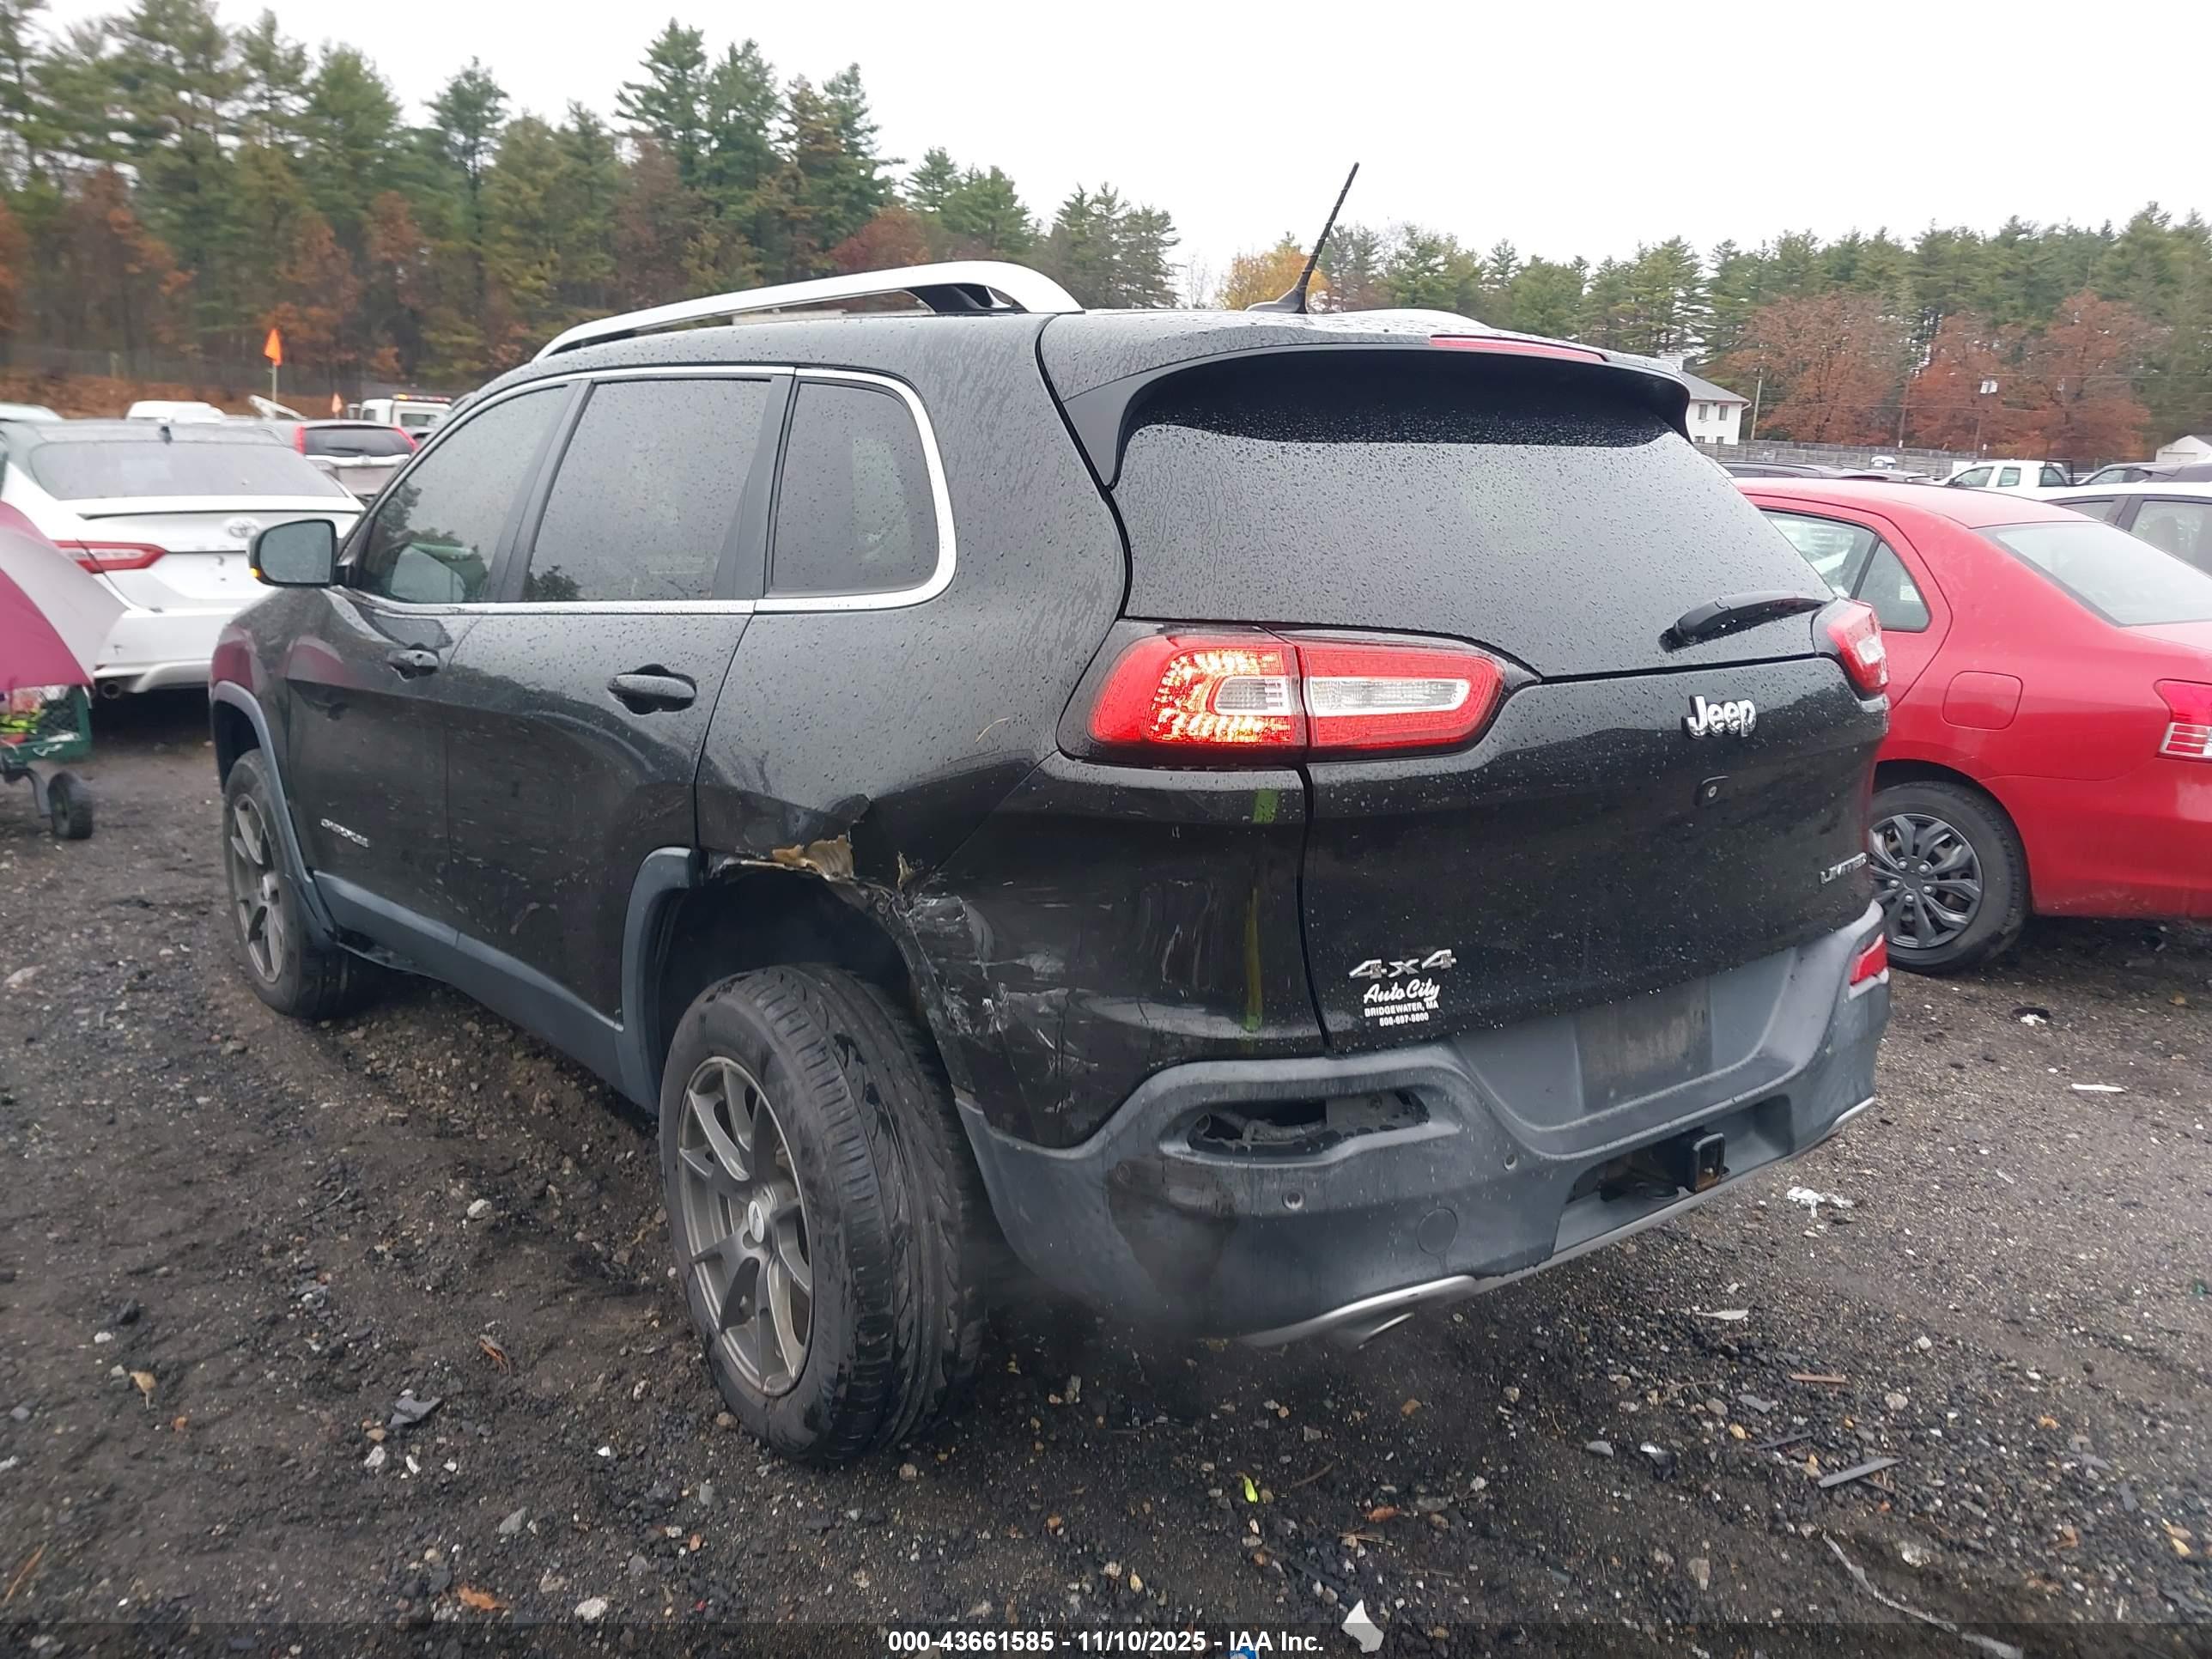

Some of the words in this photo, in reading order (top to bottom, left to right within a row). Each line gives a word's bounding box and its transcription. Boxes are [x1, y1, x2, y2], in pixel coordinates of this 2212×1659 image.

[1685, 695, 1757, 738] Jeep
[1363, 981, 1406, 1004] Auto
[1406, 977, 1441, 1002] City
[1364, 1001, 1425, 1018] BRIDGEWATER,
[1425, 1000, 1439, 1010] MA
